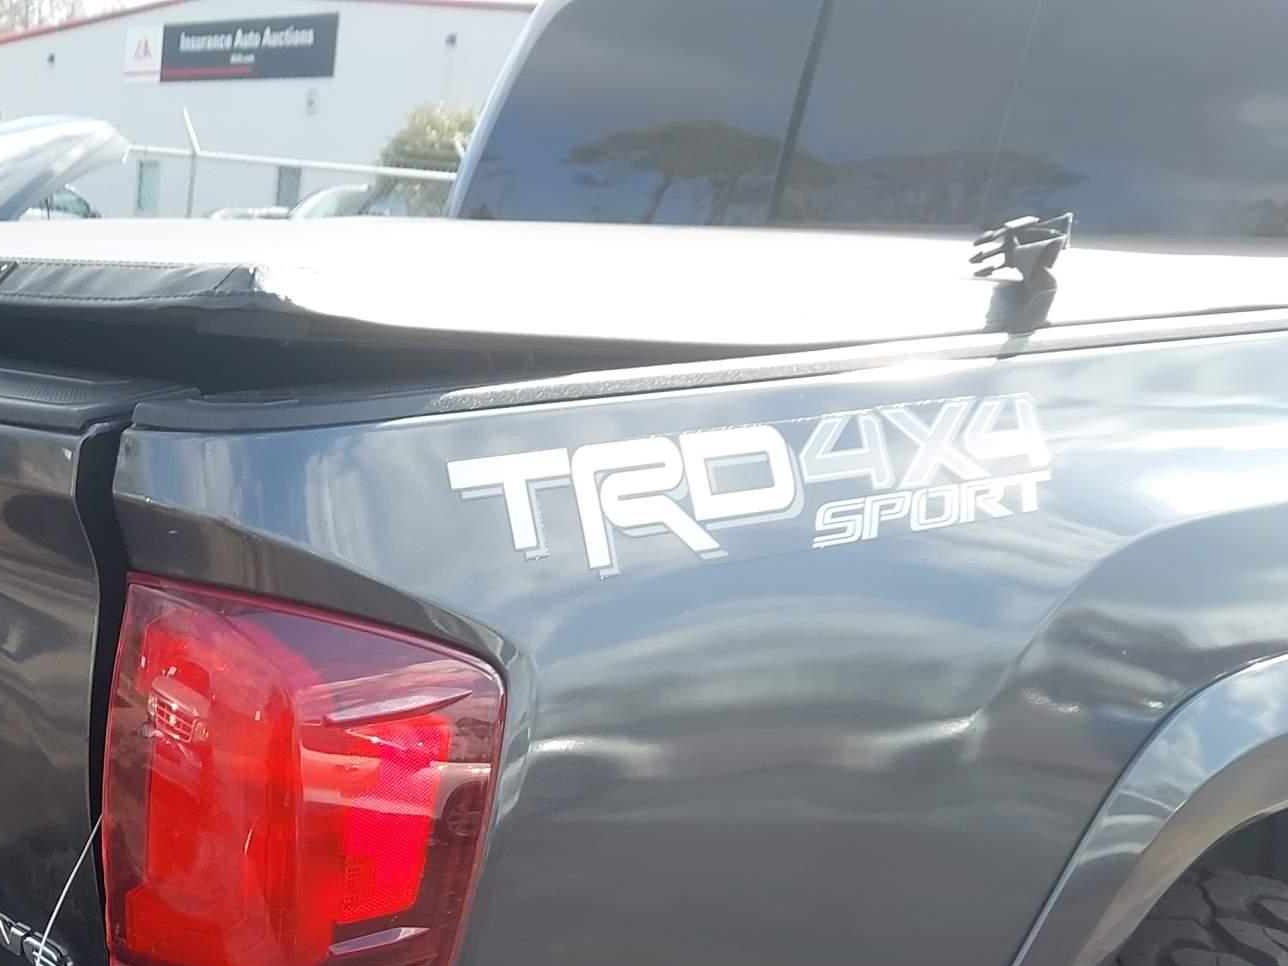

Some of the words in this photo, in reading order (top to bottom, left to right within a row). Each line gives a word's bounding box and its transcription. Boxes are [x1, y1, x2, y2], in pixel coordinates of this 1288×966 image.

[179, 31, 233, 52] Insurance
[234, 27, 261, 49] Auto
[262, 24, 315, 48] Auctions
[447, 424, 804, 579] TRD
[812, 470, 1052, 549] SPORT
